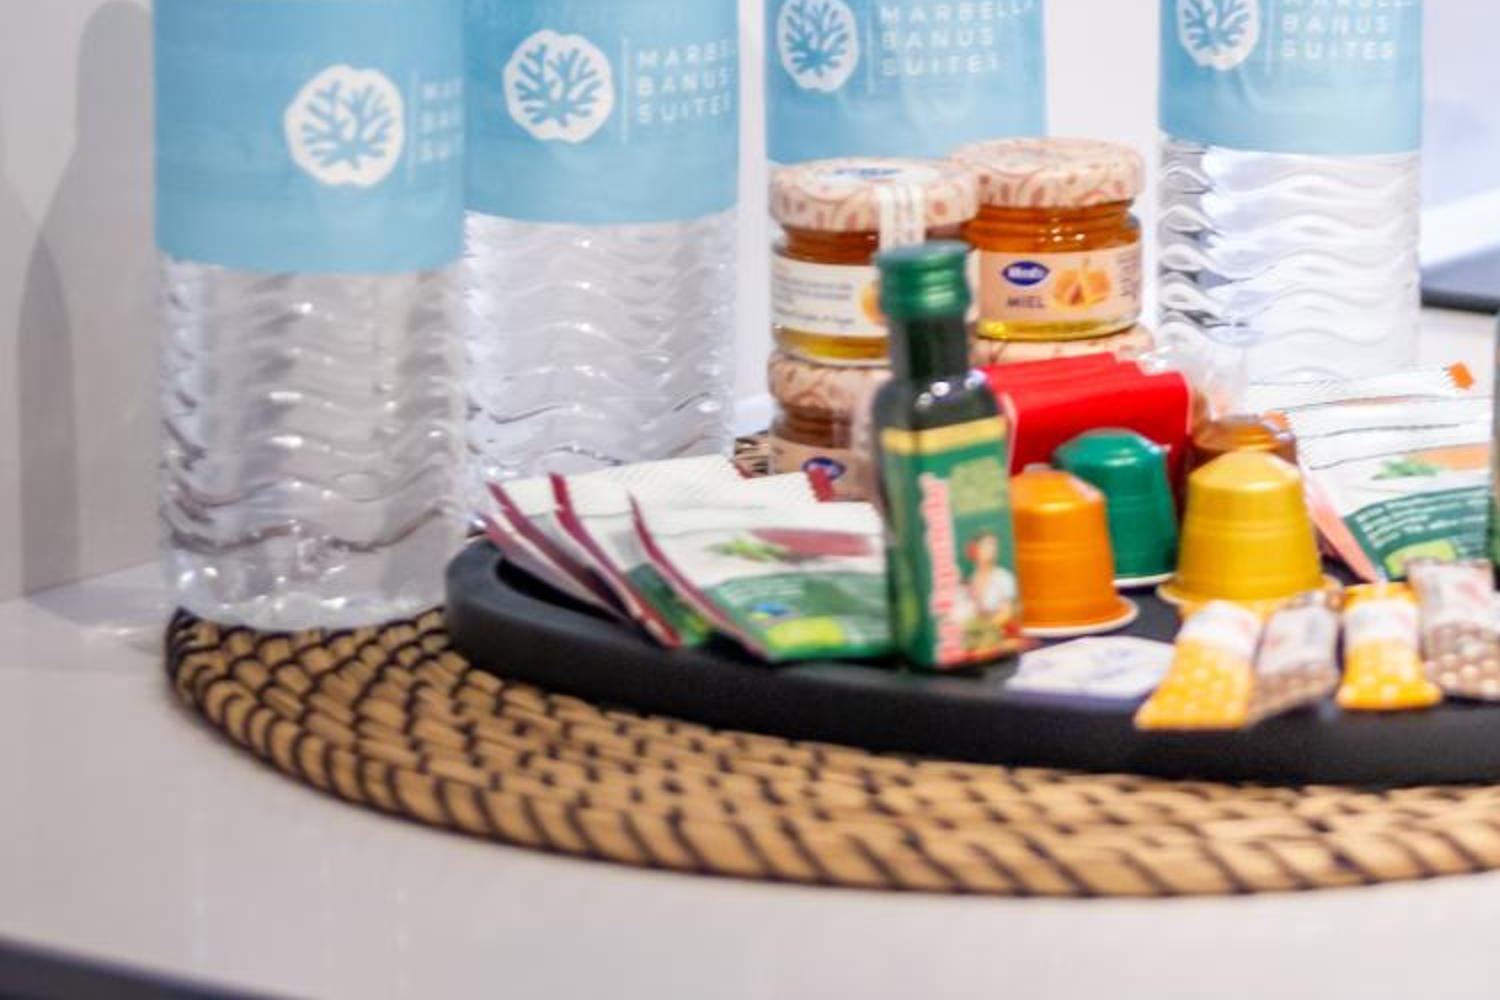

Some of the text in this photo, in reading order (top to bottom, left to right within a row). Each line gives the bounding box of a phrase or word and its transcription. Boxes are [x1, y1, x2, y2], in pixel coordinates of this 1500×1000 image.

[1281, 13, 1391, 34] BANUS
[880, 25, 994, 51] BANUS
[1281, 39, 1395, 61] SUITES
[1006, 294, 1046, 309] MIEL
